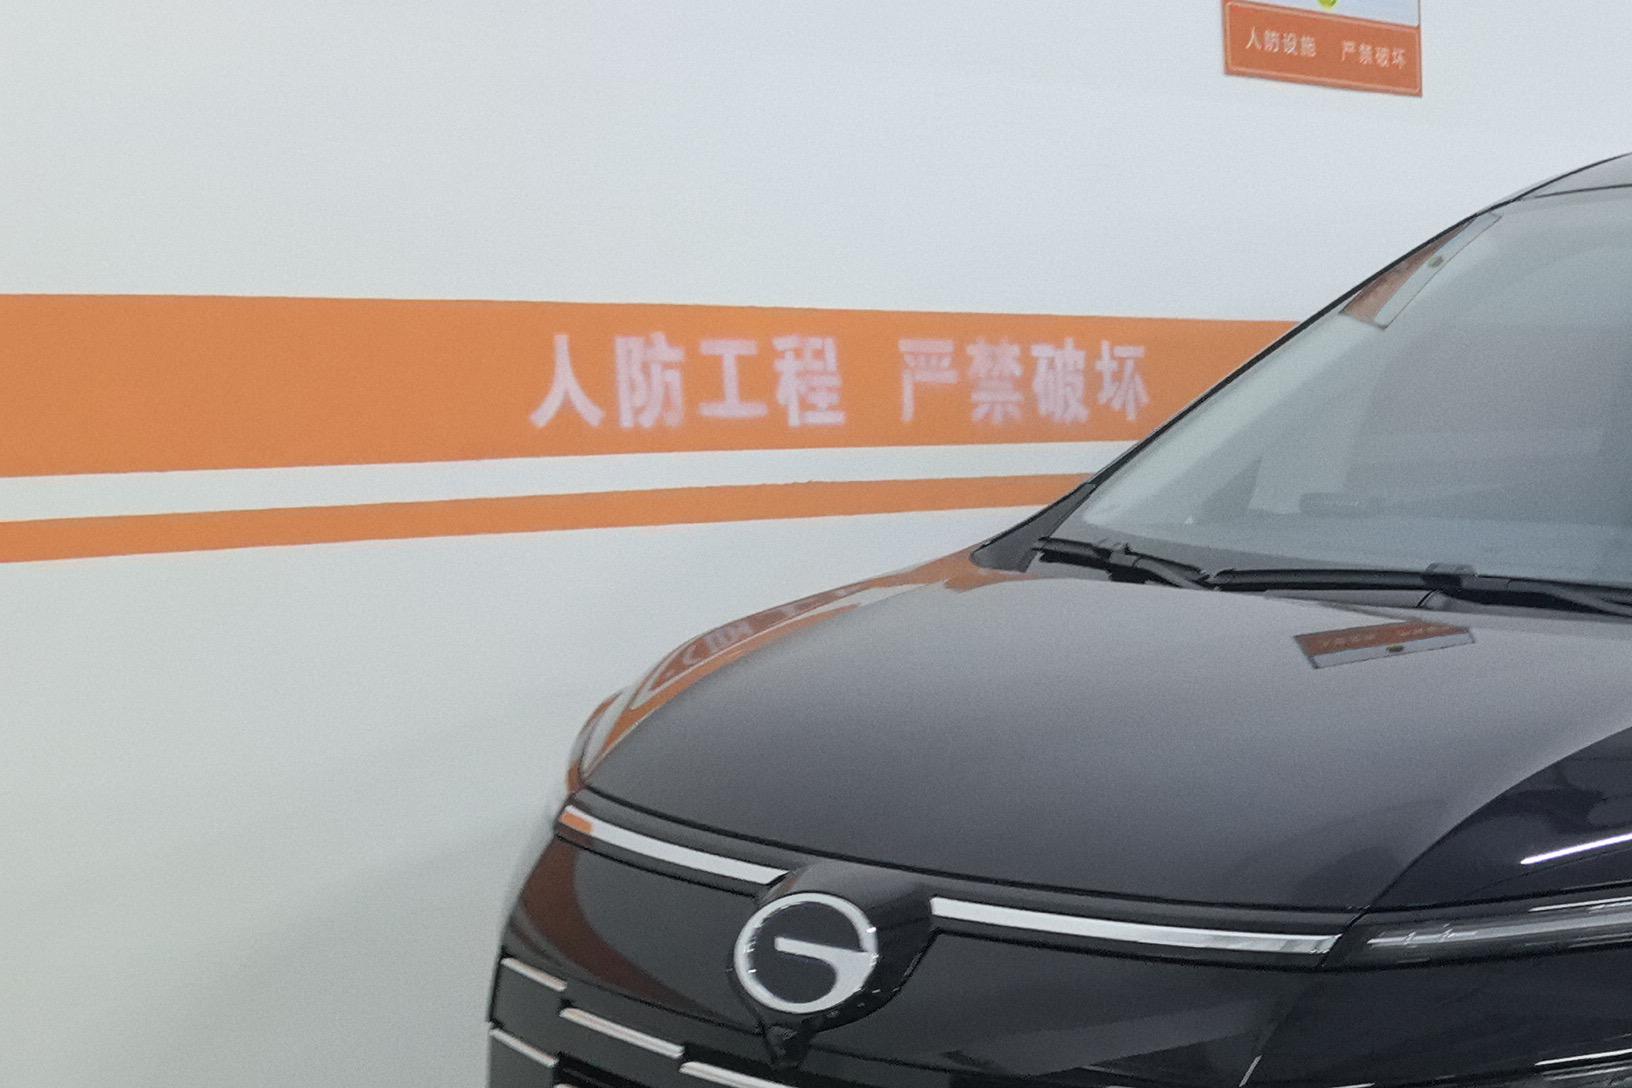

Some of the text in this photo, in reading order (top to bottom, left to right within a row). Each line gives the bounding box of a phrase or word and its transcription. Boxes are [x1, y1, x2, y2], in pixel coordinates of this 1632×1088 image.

[1245, 26, 1406, 68] 人防设施 严禁破坏
[529, 332, 1151, 430] 人防工程 严禁破坏
